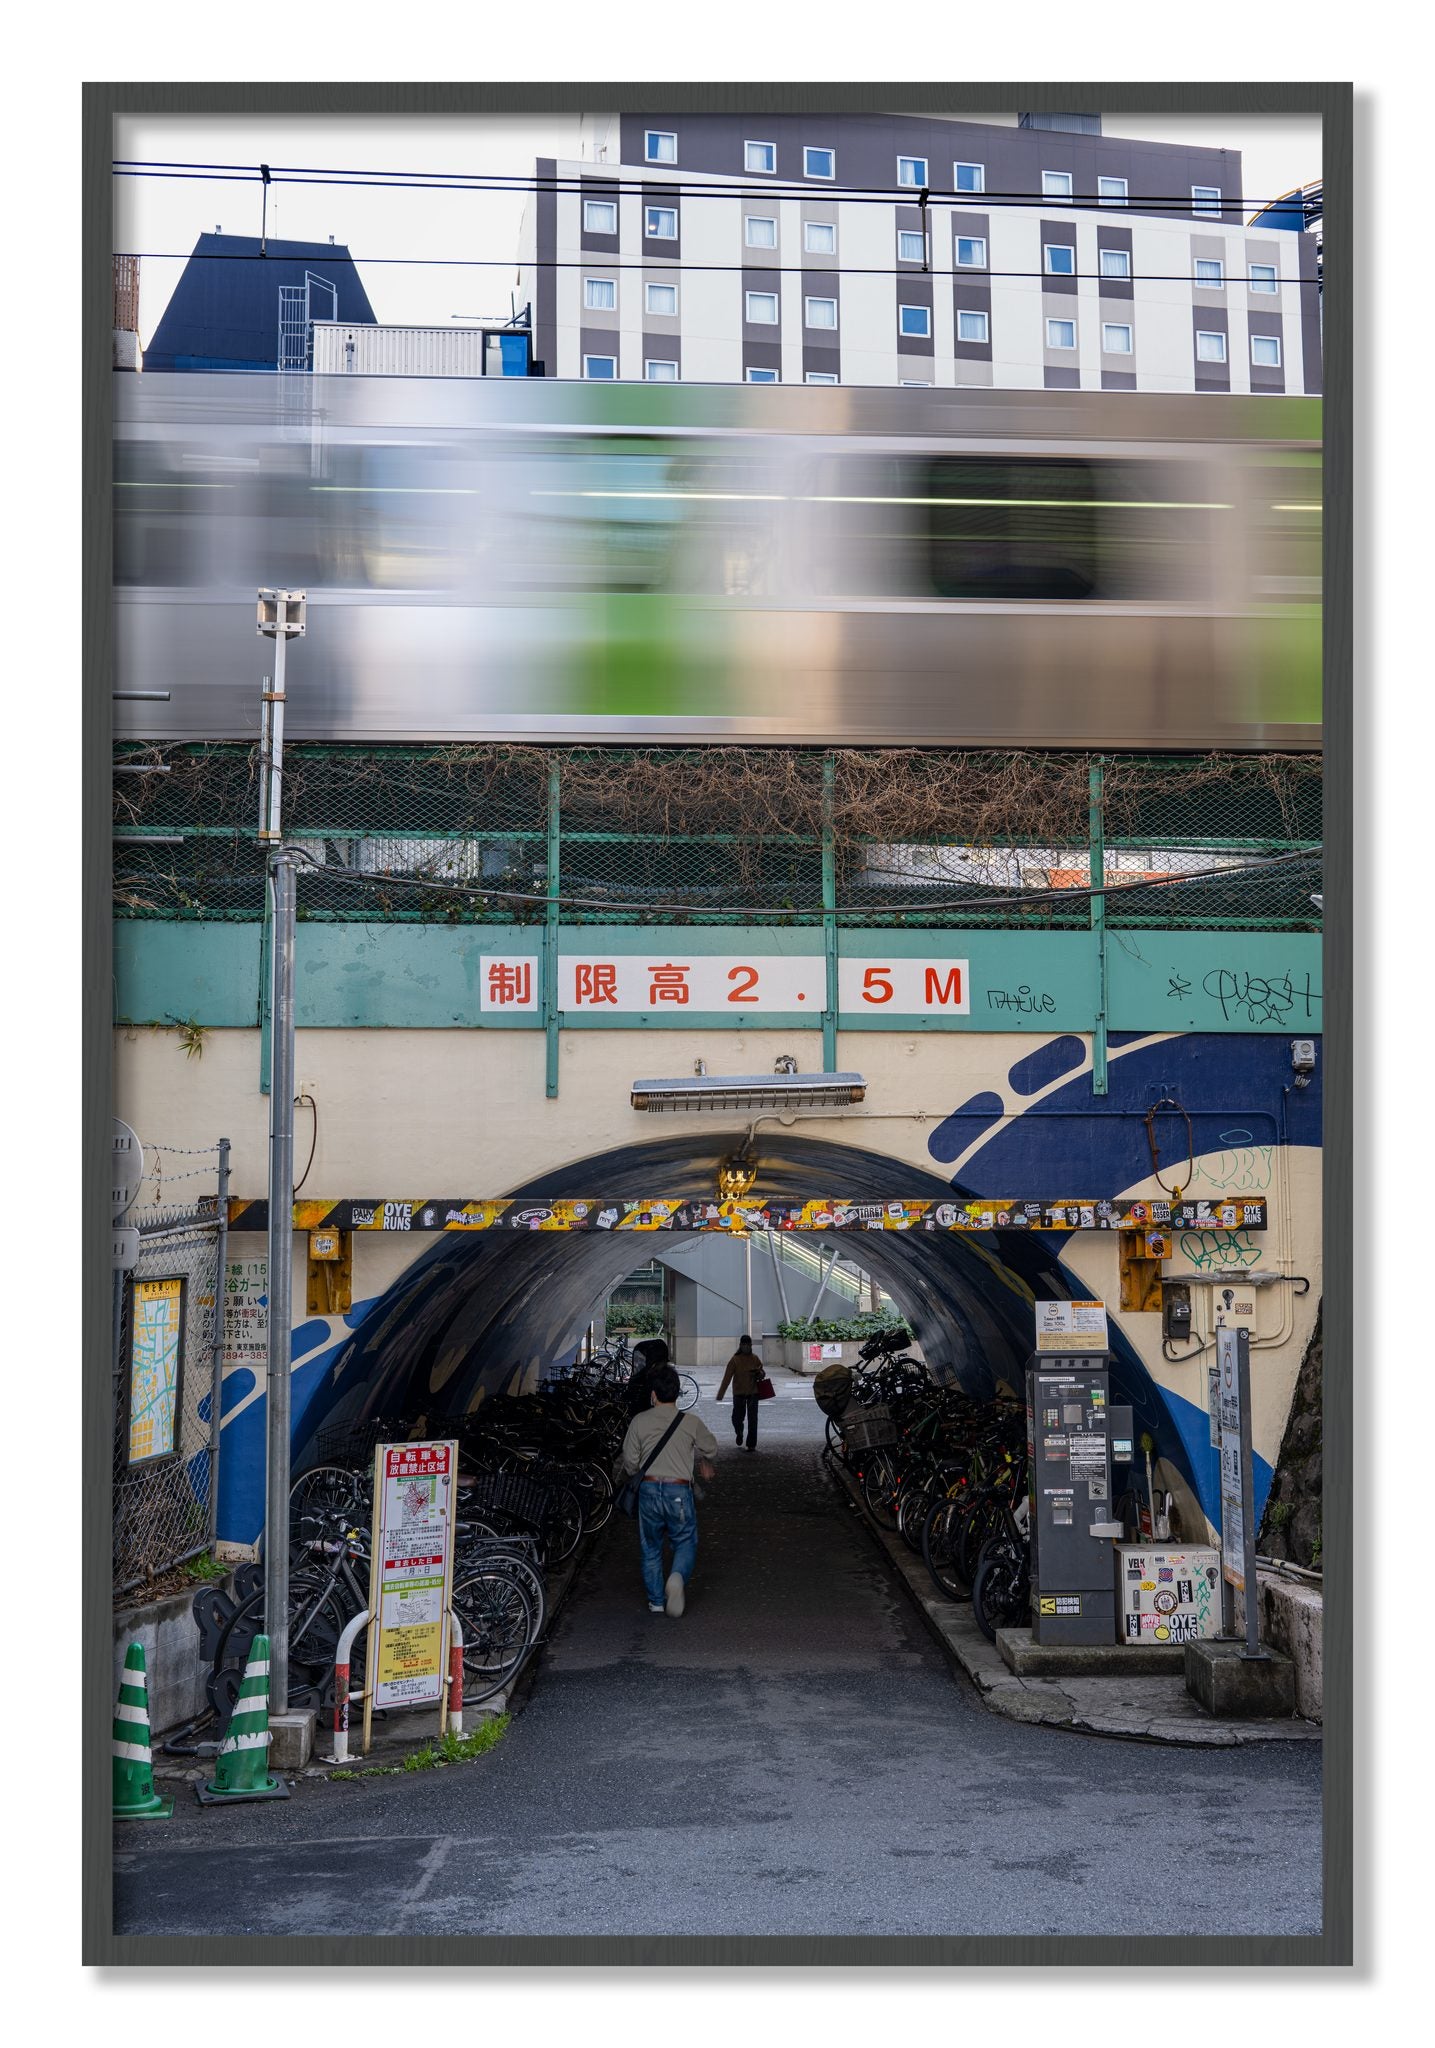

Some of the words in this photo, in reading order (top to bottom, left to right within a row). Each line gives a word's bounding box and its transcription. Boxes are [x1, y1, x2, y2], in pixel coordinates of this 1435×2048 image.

[384, 1202, 412, 1217] OYE
[1244, 1205, 1261, 1214] OYE
[383, 1216, 411, 1230] RUNS
[1244, 1214, 1262, 1223] RUNS
[223, 1296, 257, 1307] お願い
[389, 1461, 446, 1475] 放置禁止区域
[1169, 1614, 1197, 1629] OYE
[1170, 1628, 1198, 1643] RUNS
